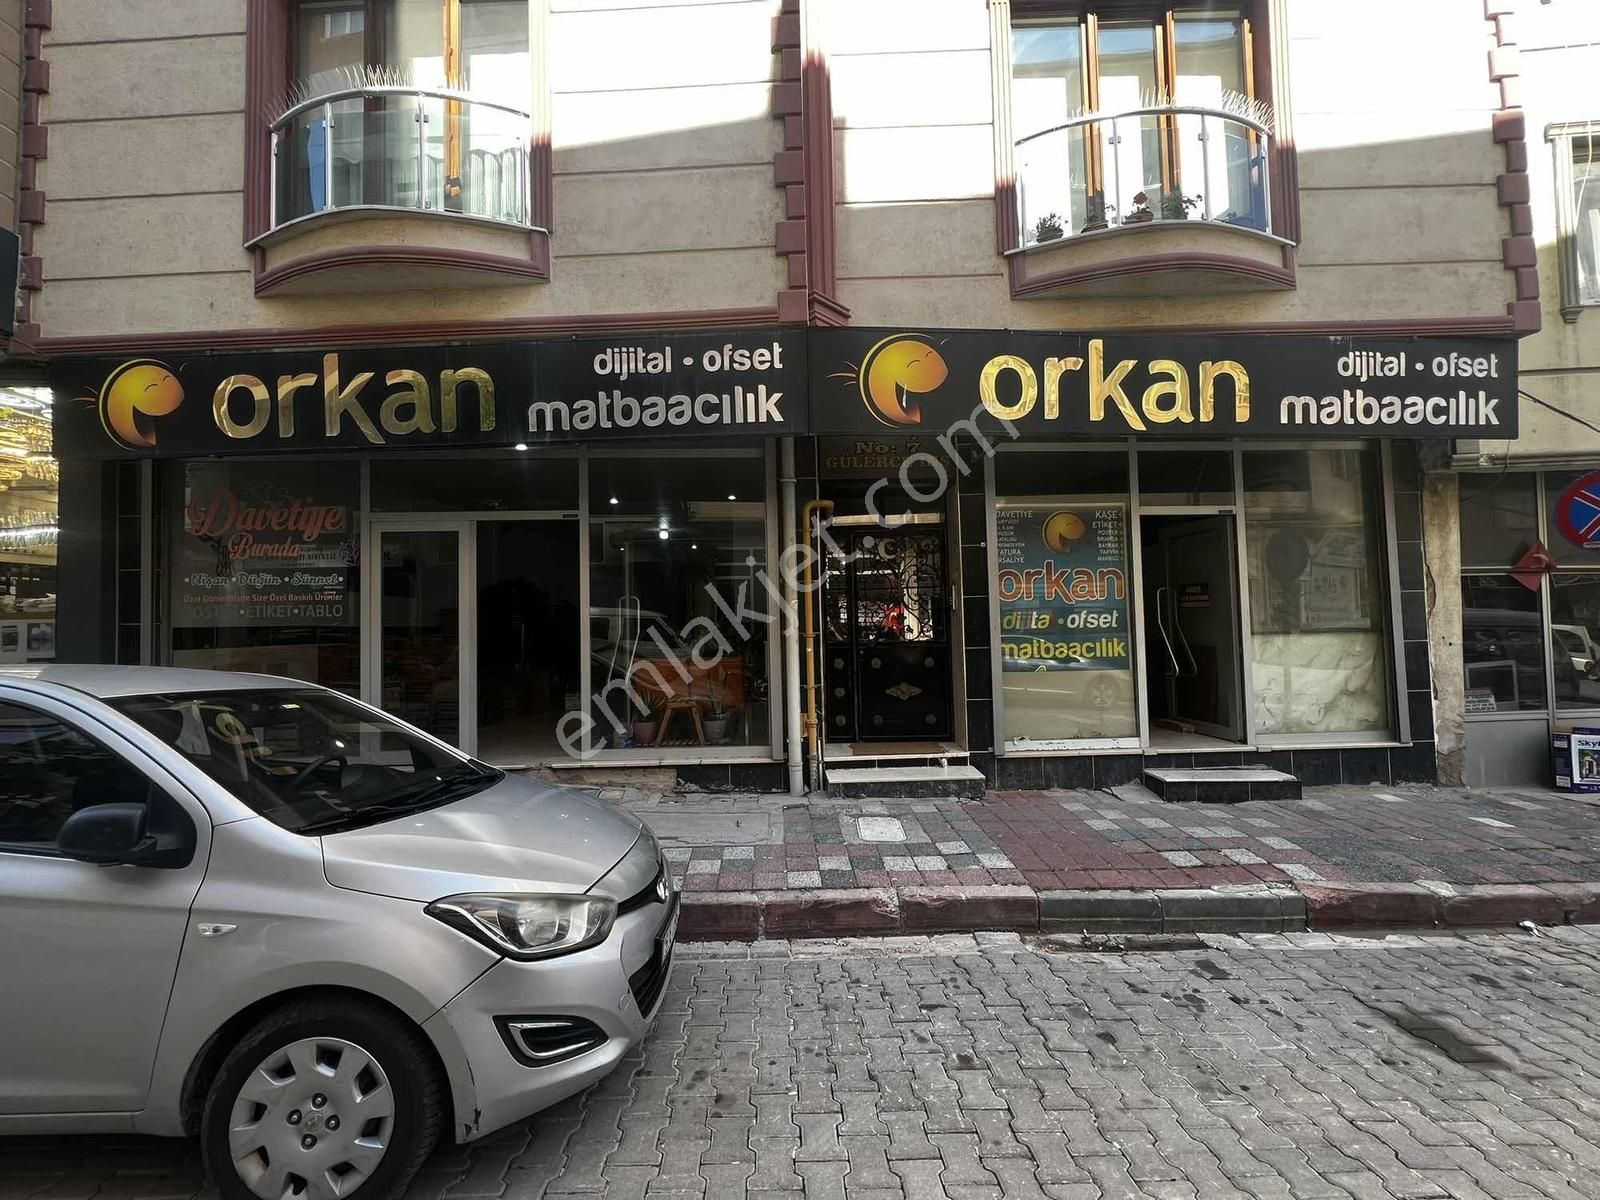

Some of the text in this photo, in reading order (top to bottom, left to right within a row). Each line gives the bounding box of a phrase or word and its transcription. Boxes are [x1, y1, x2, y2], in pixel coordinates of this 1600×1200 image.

[593, 342, 783, 381] dijital ofset
[1337, 351, 1499, 382] dijital ofset
[212, 353, 496, 444] orkan
[979, 339, 1250, 431] orkan
[528, 384, 784, 432] matbaacılık
[1280, 389, 1500, 425] matbaacılık
[227, 532, 301, 560] Burada
[998, 559, 1126, 605] orkan
[300, 604, 343, 617] TABLO
[1067, 610, 1119, 629] ofset
